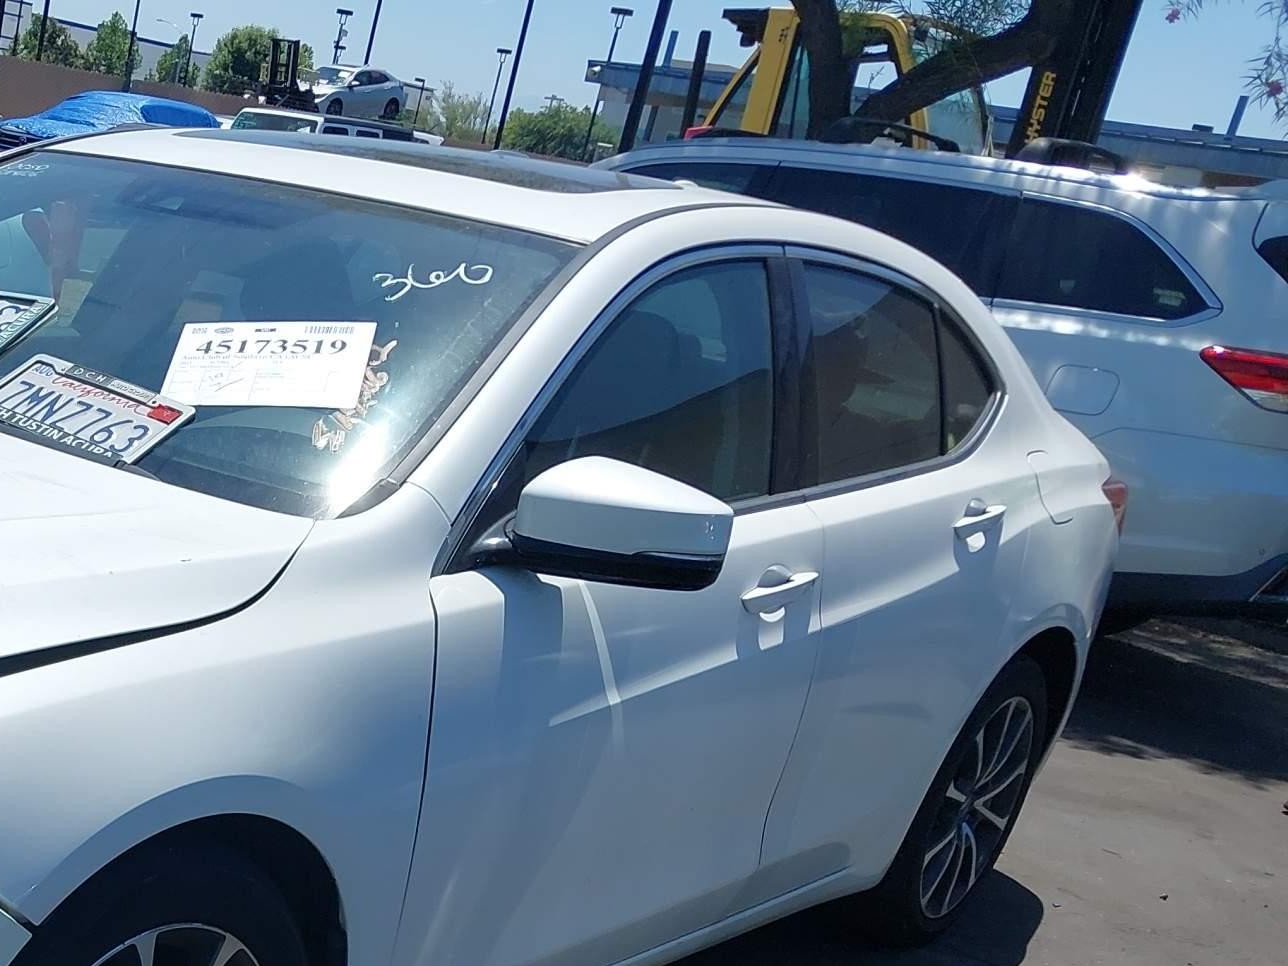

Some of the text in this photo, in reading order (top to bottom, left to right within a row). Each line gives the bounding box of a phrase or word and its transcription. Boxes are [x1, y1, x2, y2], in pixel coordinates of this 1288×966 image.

[1024, 71, 1057, 144] HYSTER
[2, 305, 43, 340] ACURA
[196, 339, 347, 355] 45173519
[73, 367, 108, 383] DCH
[51, 375, 148, 417] California
[0, 380, 150, 453] 7MNZ763
[12, 414, 64, 439] TUSTIN
